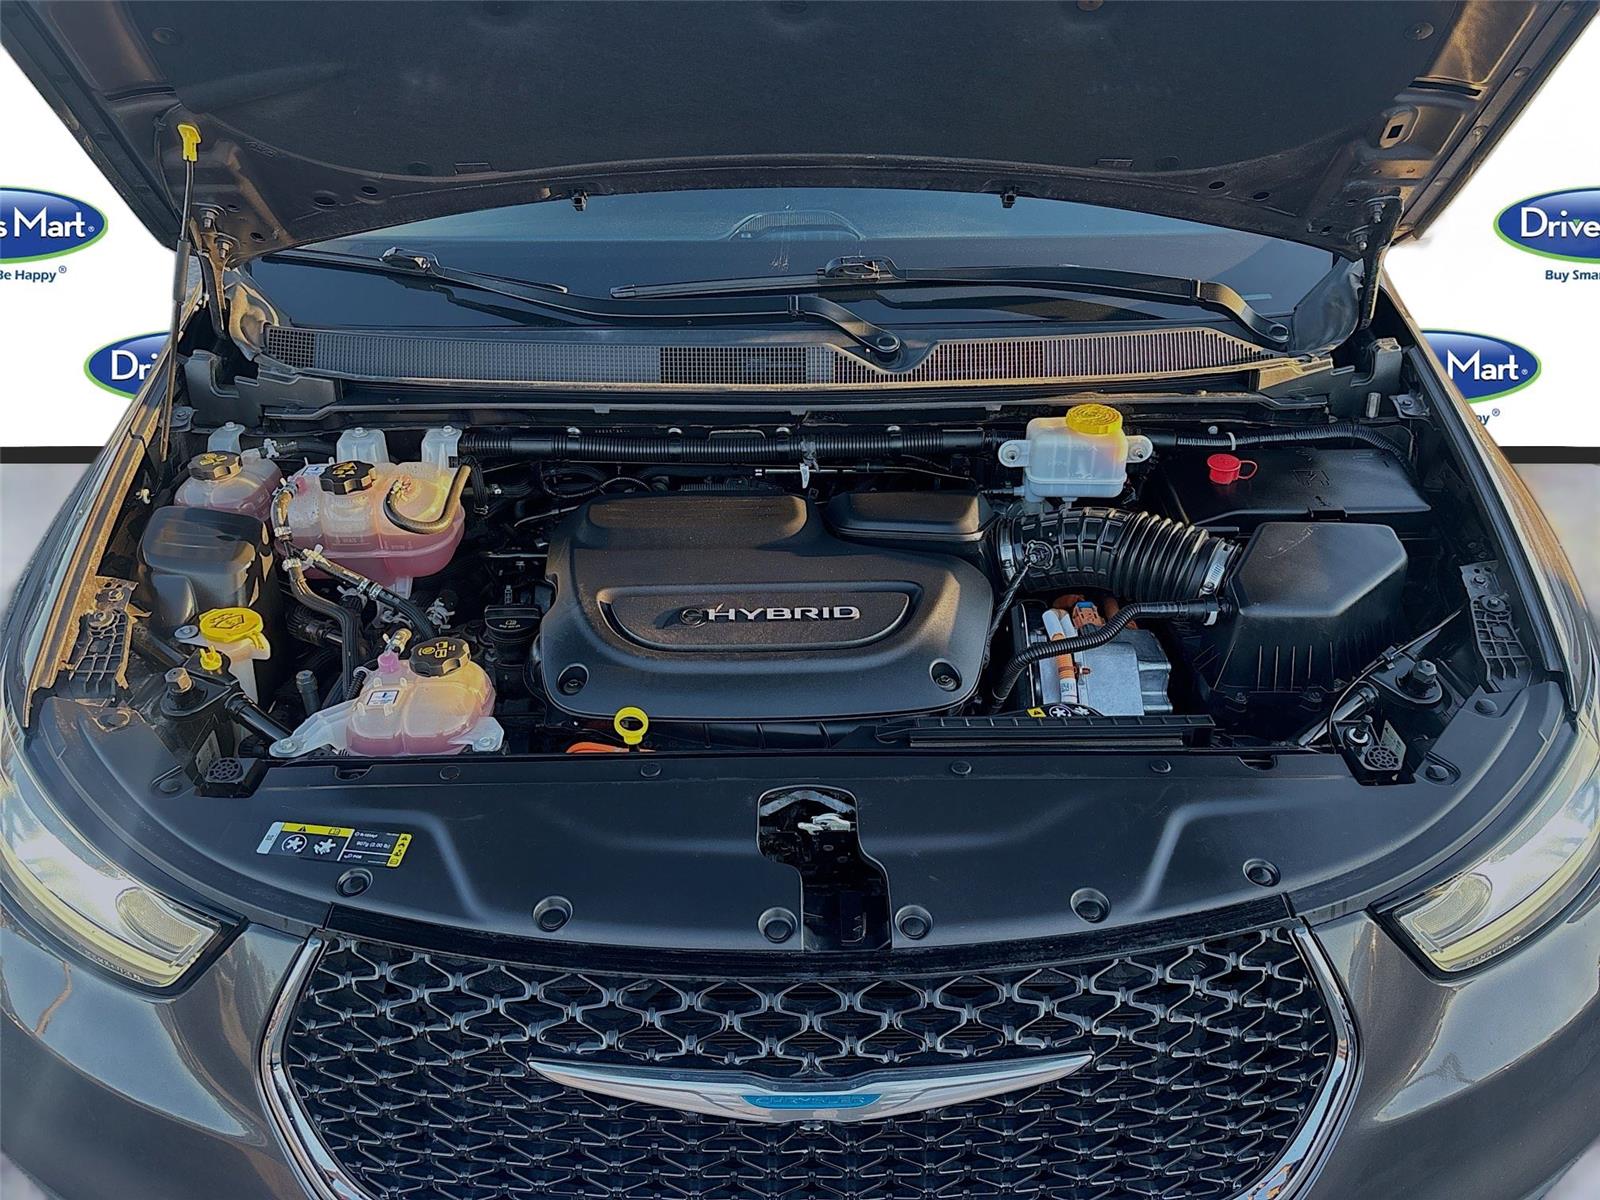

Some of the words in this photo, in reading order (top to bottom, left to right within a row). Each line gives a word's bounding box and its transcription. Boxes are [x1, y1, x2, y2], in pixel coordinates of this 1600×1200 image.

[14, 206, 86, 238] Mart
[1521, 206, 1600, 238] Drive
[15, 270, 57, 283] Happy
[1545, 269, 1570, 283] Buy
[1447, 348, 1519, 380] Mart
